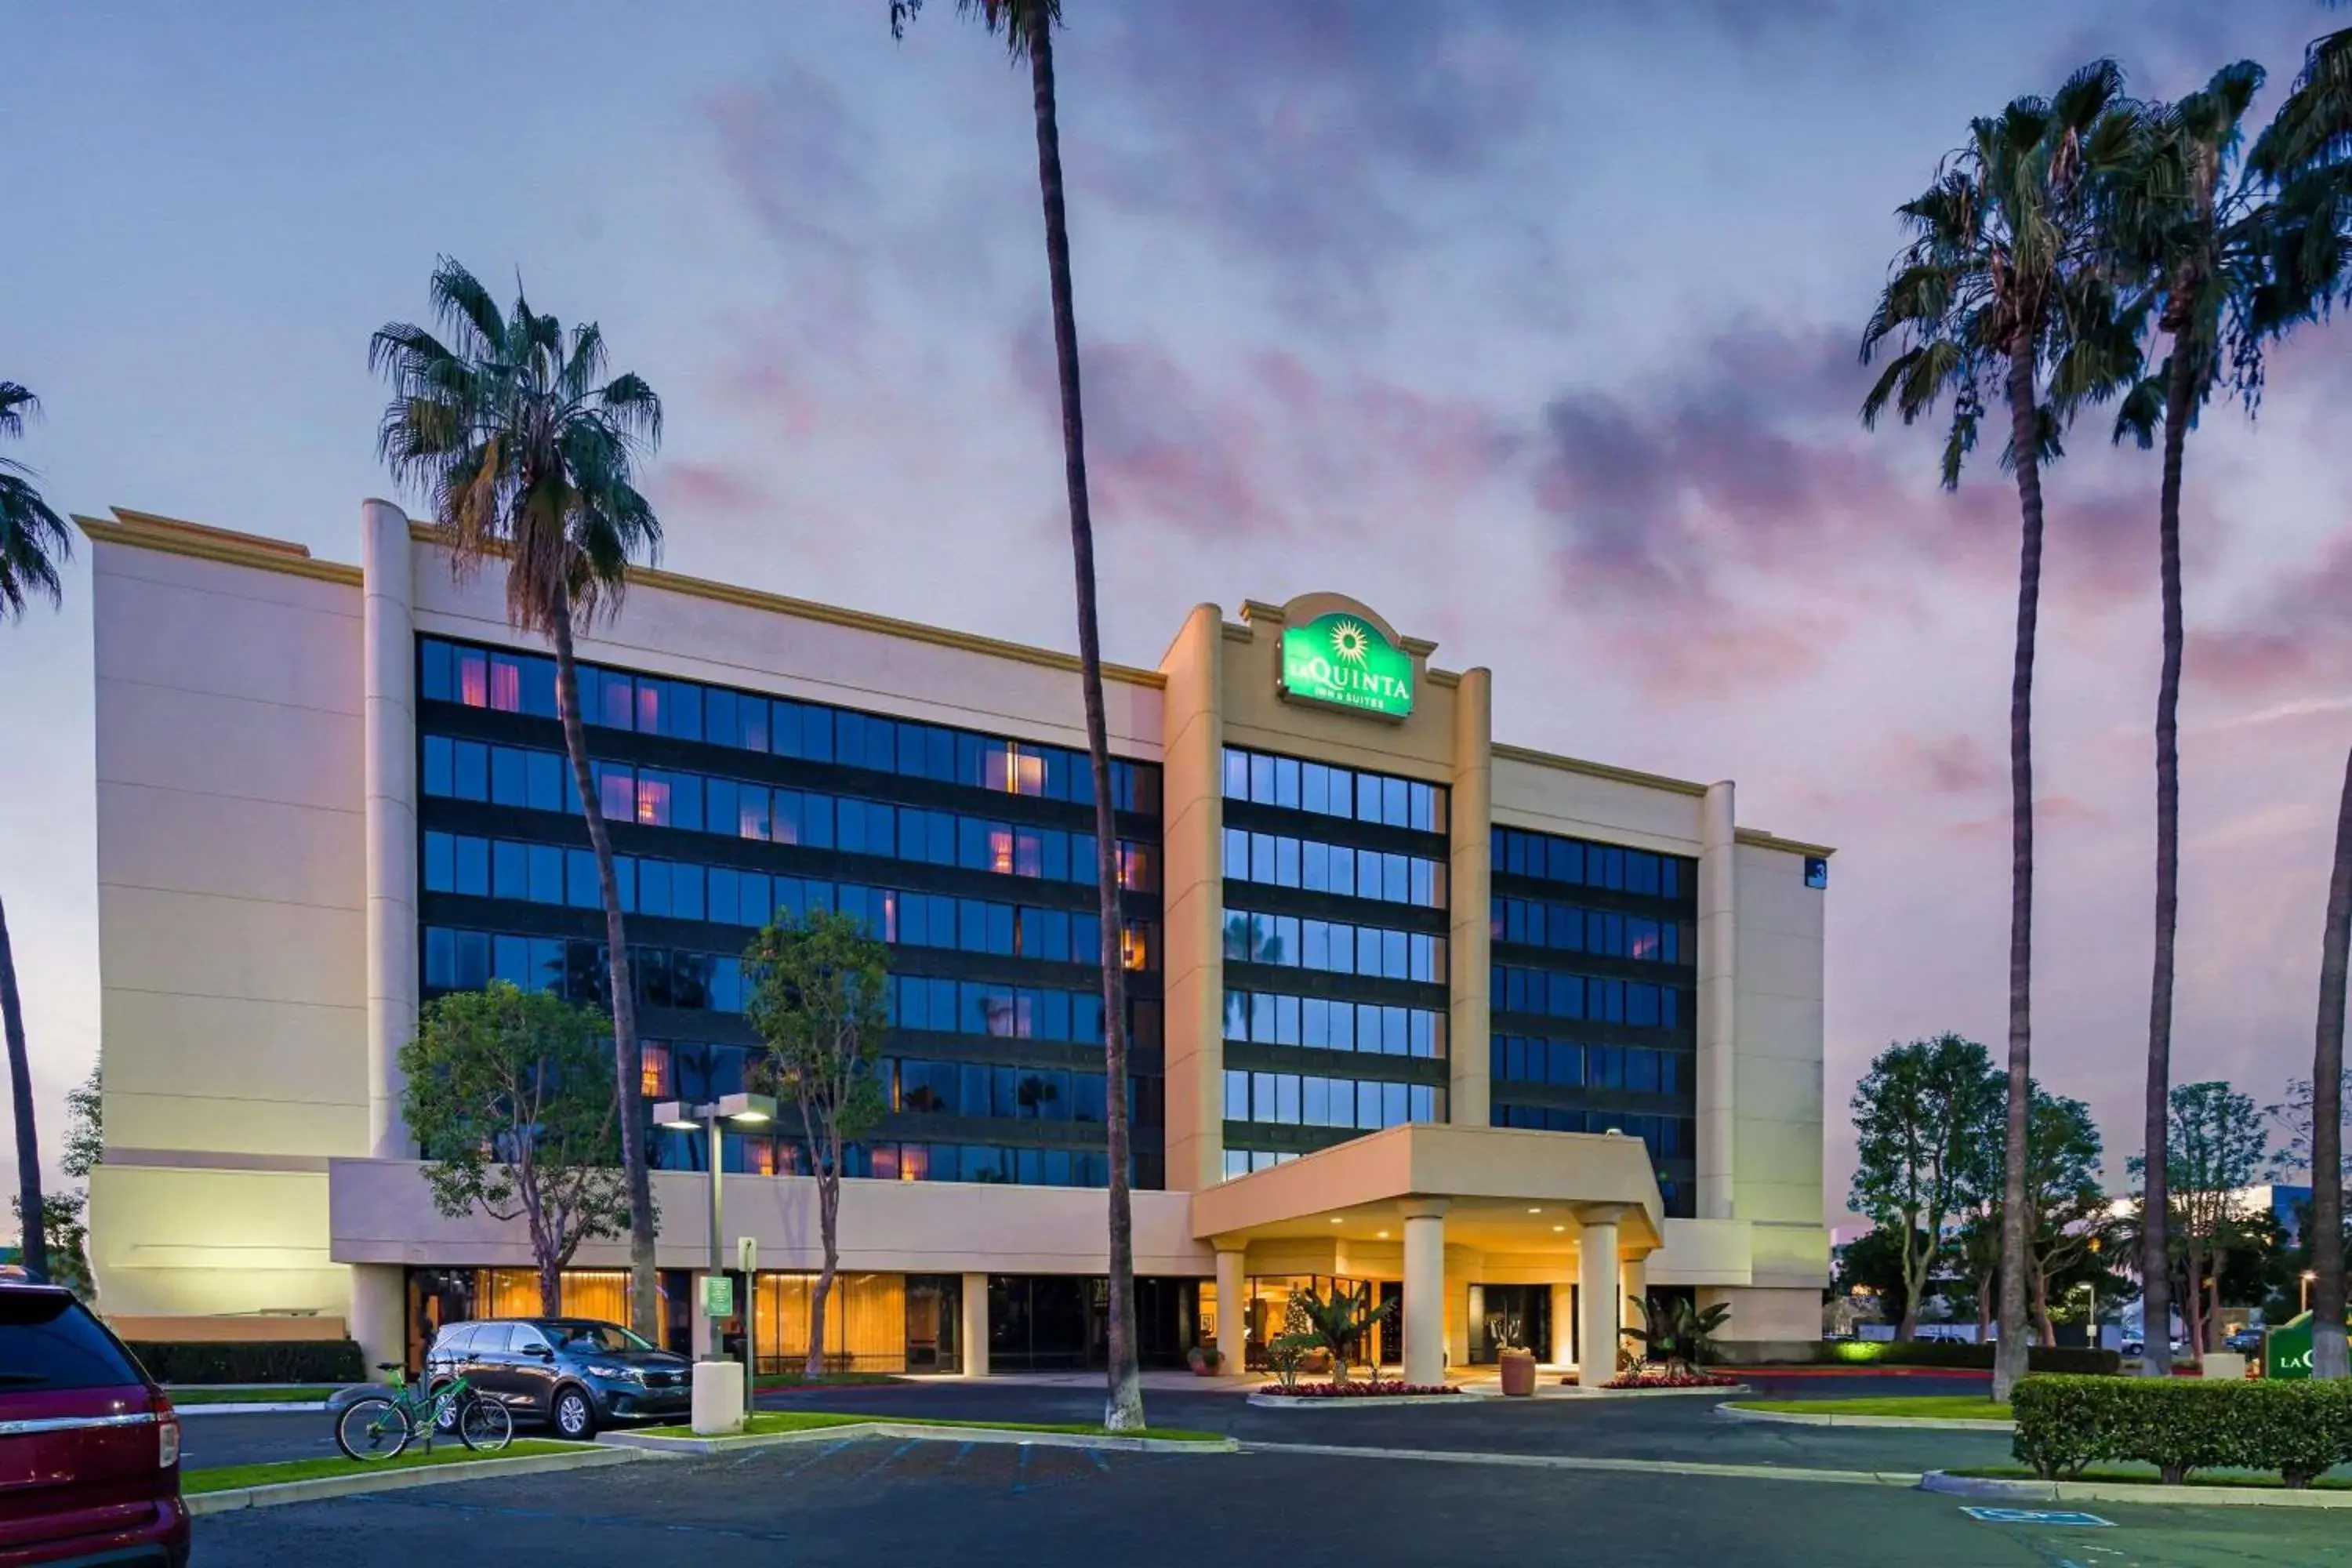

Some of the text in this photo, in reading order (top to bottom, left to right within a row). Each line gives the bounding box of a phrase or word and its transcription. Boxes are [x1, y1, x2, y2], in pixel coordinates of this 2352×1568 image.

[1308, 656, 1410, 699] QUINTA
[1346, 693, 1385, 709] SUITES
[2280, 1357, 2302, 1368] LA
